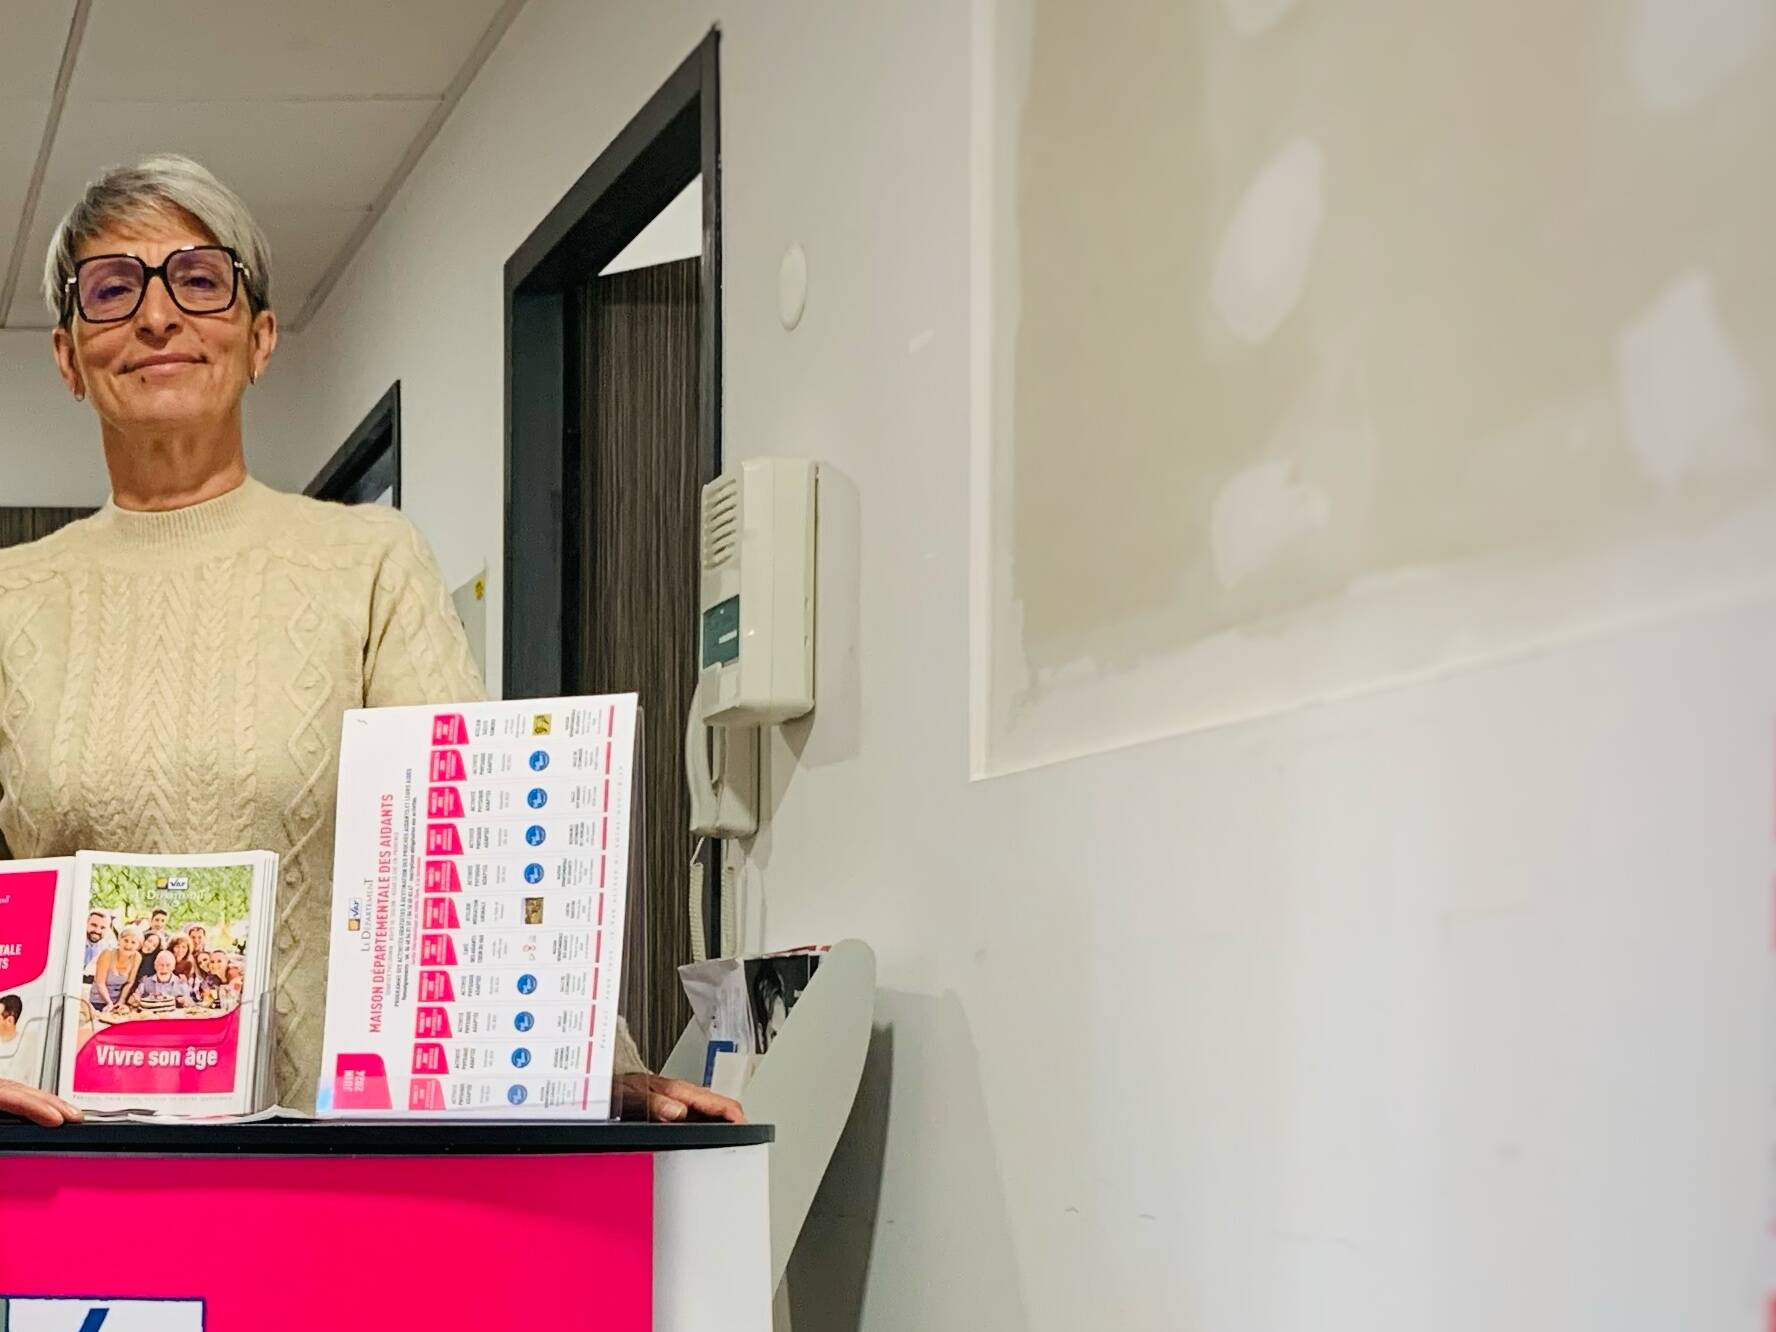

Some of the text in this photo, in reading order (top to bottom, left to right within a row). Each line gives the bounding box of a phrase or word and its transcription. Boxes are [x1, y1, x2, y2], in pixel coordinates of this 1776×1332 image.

[379, 794, 393, 848] AIDANTS
[378, 851, 392, 873] DES
[371, 876, 390, 983] DÉPARTEMENTALE
[369, 987, 384, 1033] MAISON
[96, 1045, 218, 1070] Vivre son âge
[344, 1069, 355, 1093] JUIN
[354, 1069, 366, 1093] 2024
